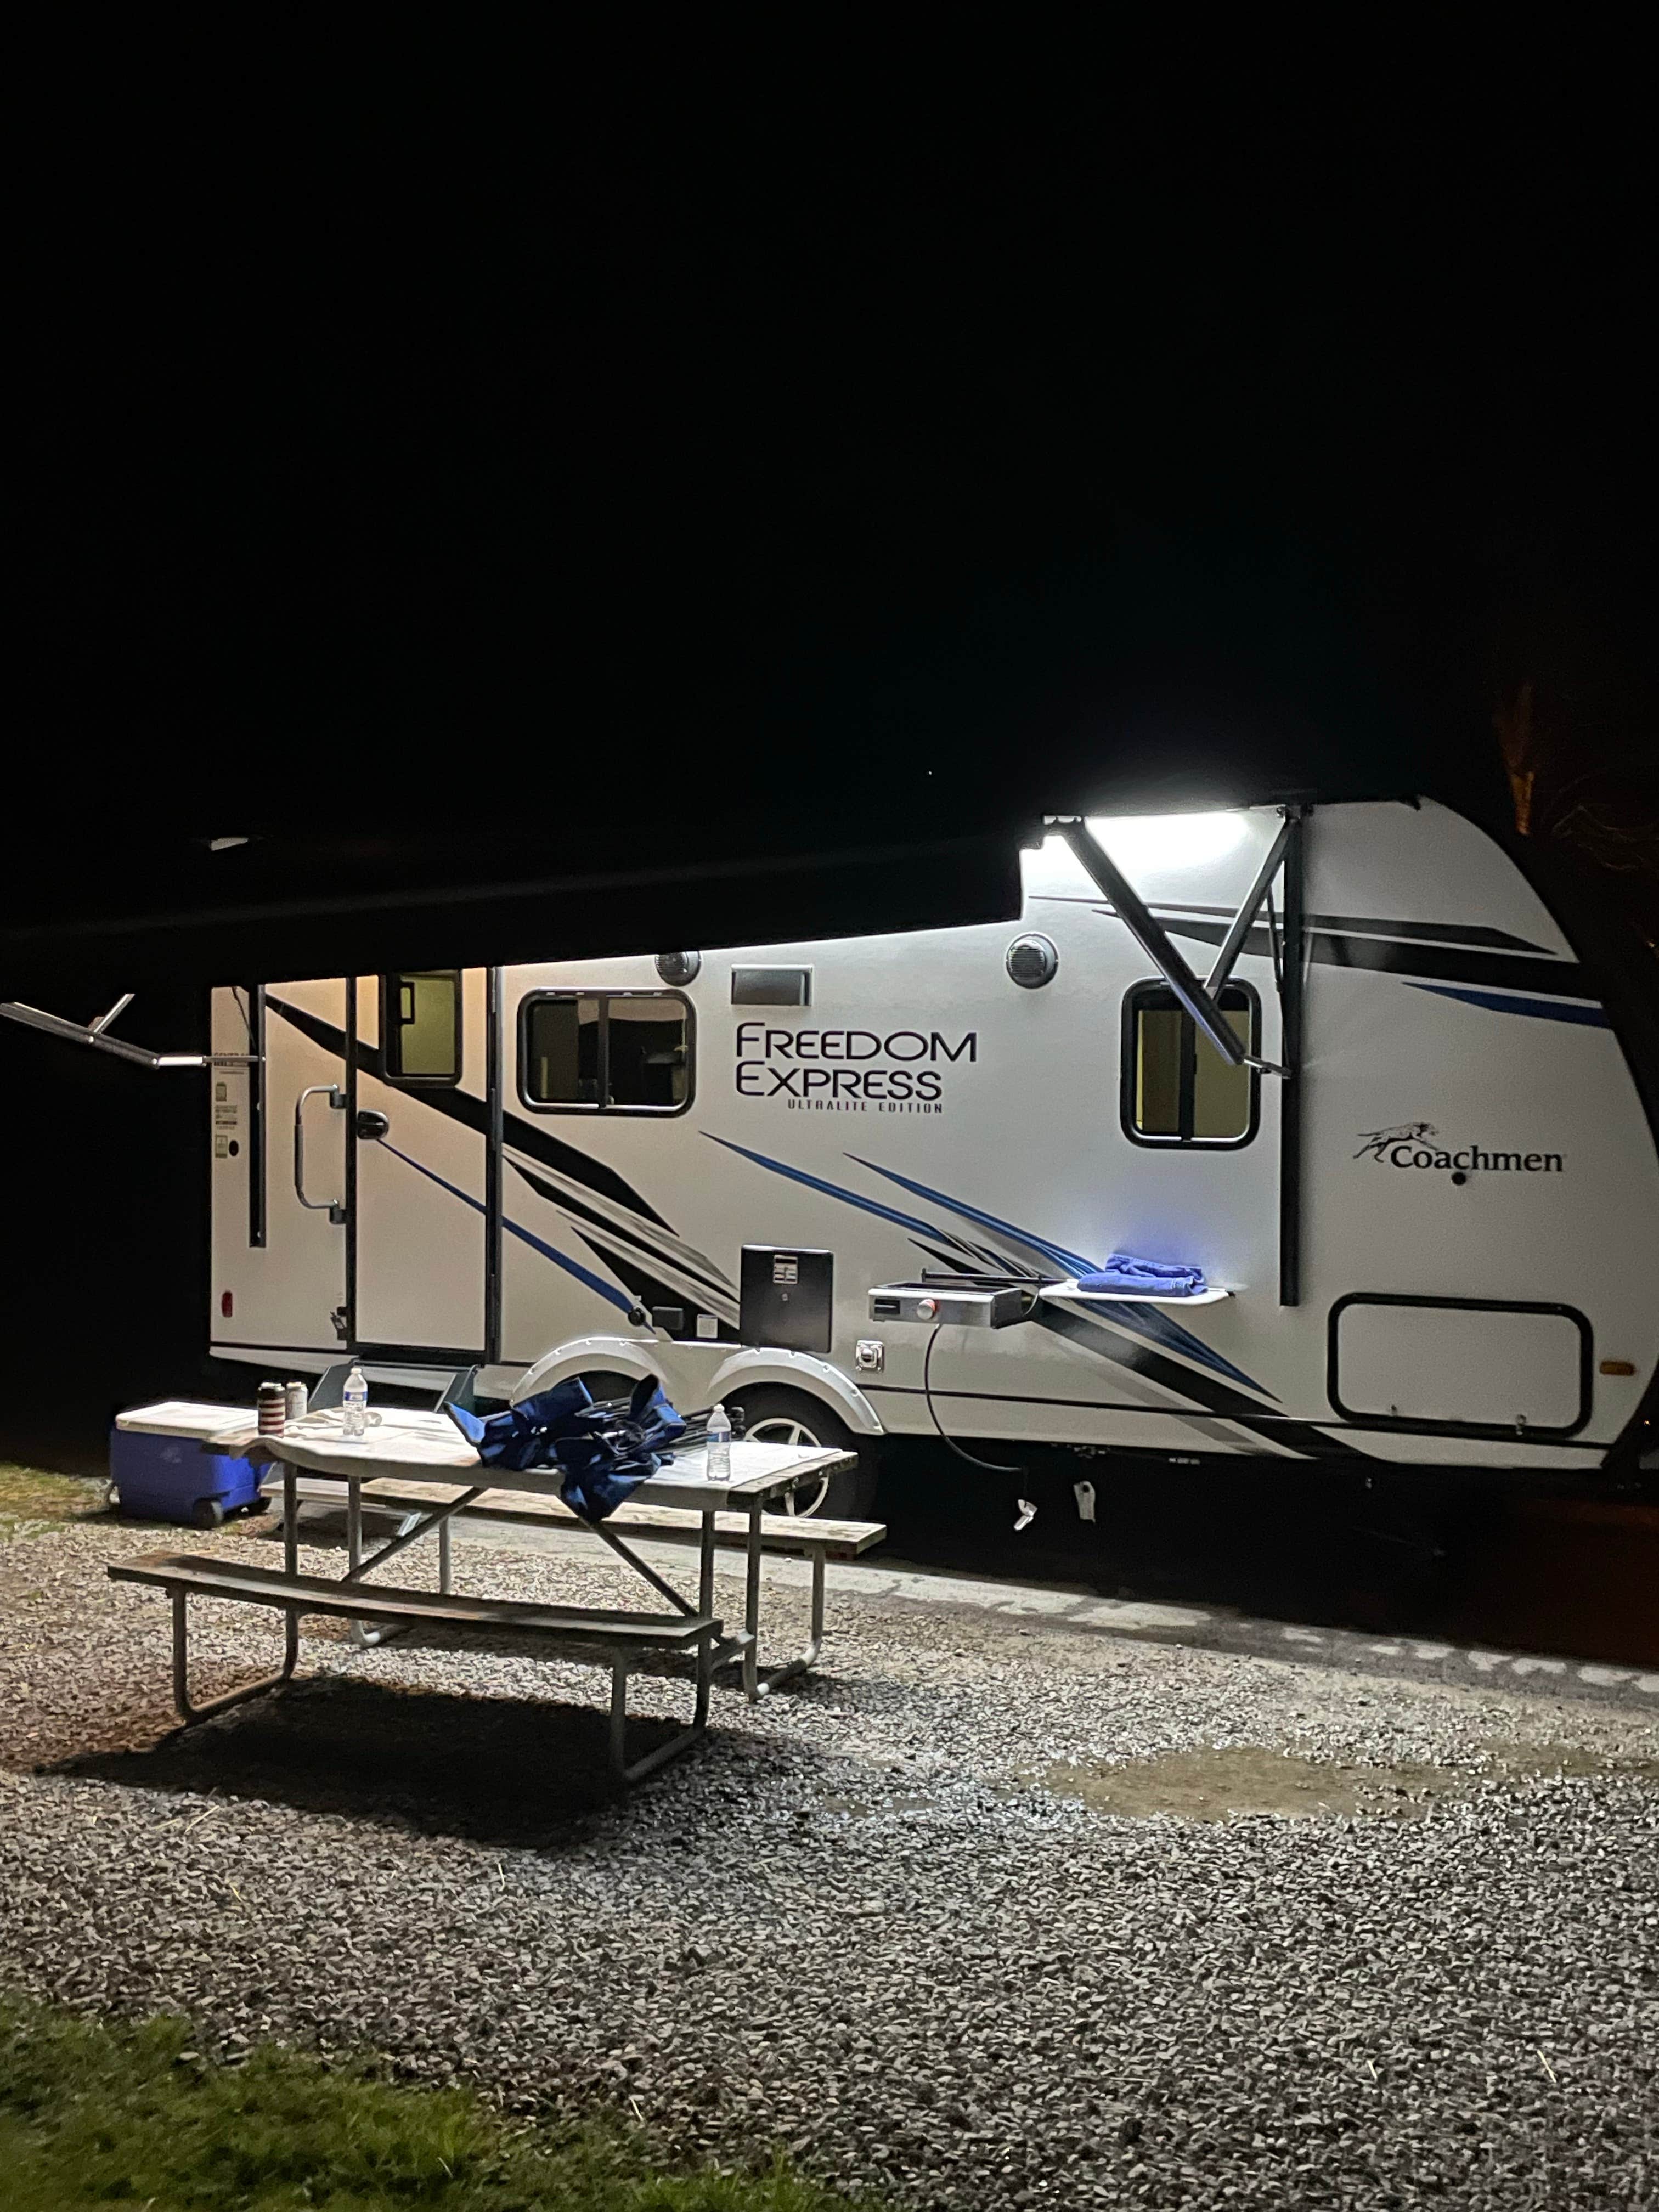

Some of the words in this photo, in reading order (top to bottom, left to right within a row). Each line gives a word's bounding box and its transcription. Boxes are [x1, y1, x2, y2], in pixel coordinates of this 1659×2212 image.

[736, 1022, 978, 1062] FREEDOM
[736, 1061, 943, 1101] EXPRESS
[788, 1099, 868, 1112] ULTRALITE
[879, 1102, 943, 1114] EDITION
[1391, 1145, 1564, 1172] Coachmen
